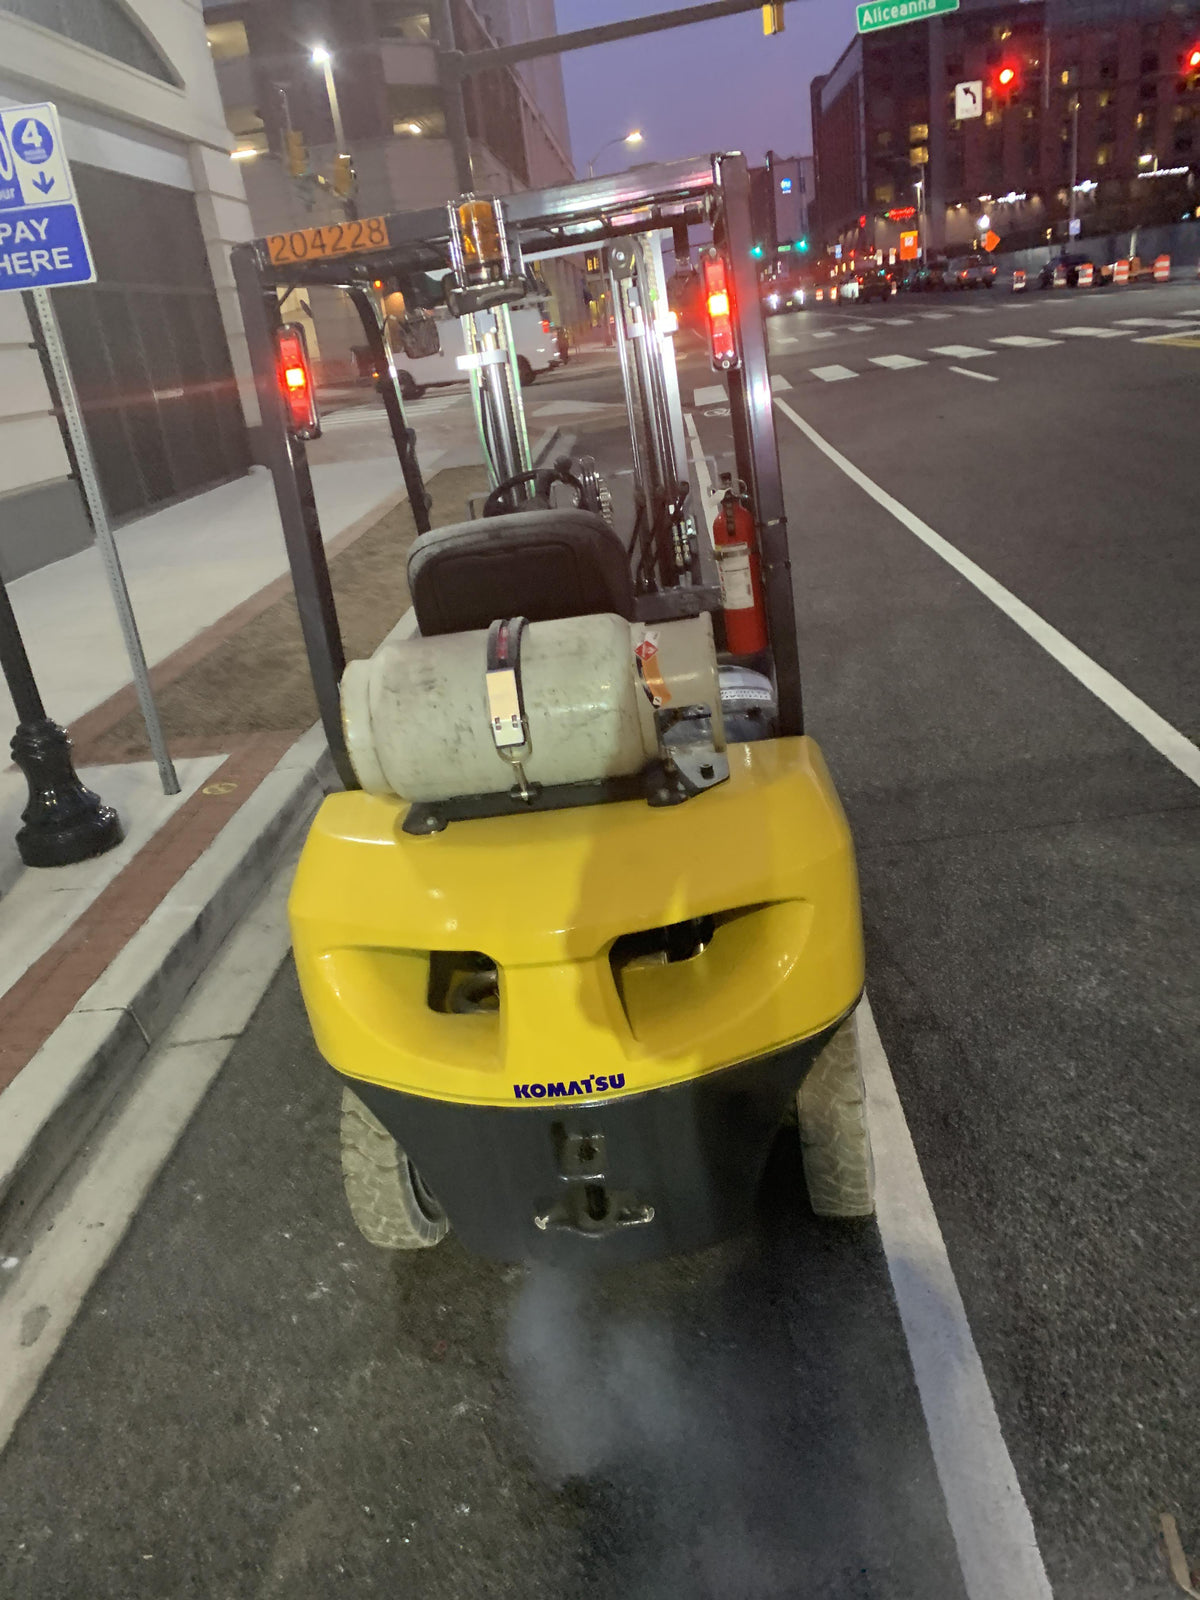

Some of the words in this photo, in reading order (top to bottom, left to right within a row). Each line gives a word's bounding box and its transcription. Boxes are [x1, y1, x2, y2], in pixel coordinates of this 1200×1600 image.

[862, 0, 936, 27] Aliceanna
[21, 119, 43, 148] 4
[0, 217, 49, 245] PAY
[271, 217, 385, 262] 204228
[0, 247, 73, 275] HERE
[513, 1072, 626, 1099] KOMATSU
